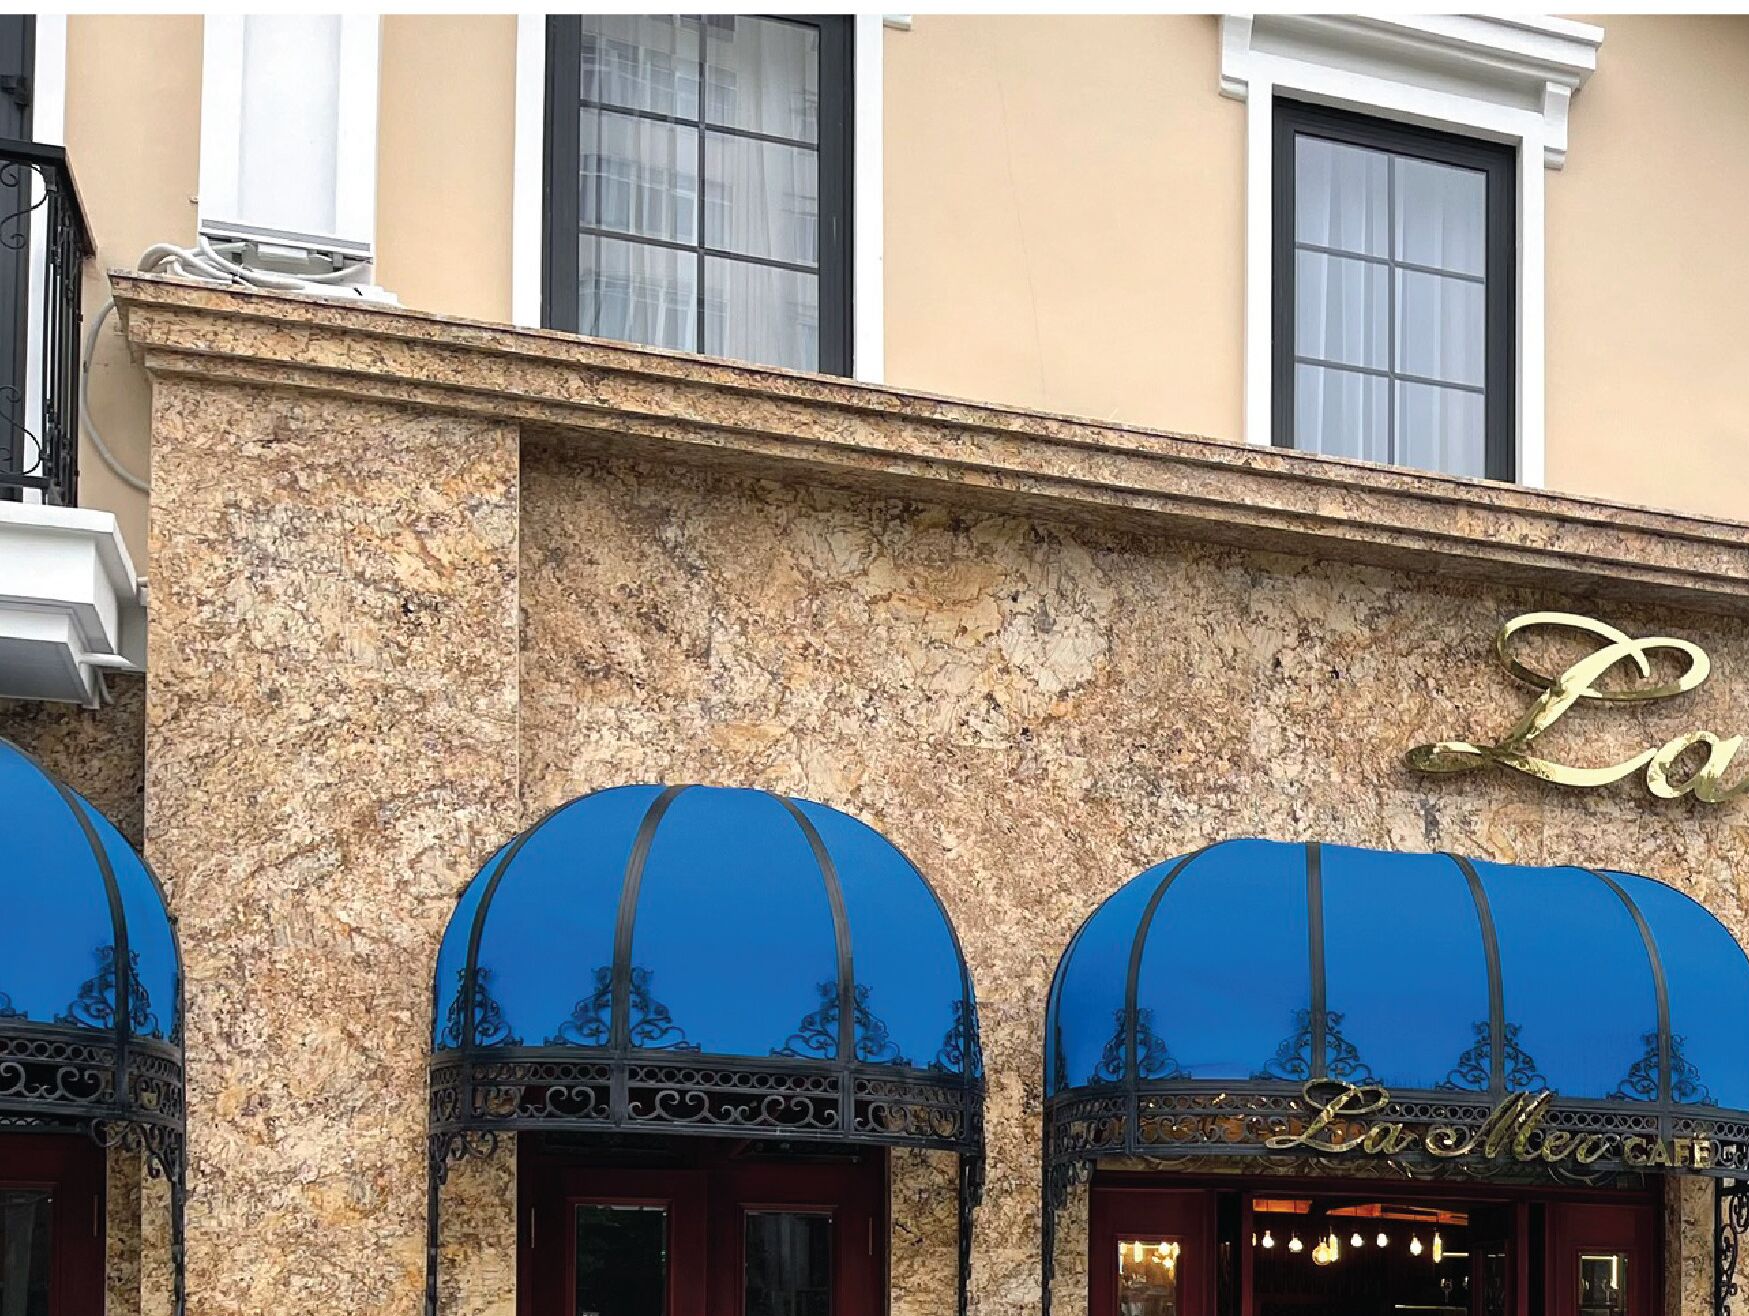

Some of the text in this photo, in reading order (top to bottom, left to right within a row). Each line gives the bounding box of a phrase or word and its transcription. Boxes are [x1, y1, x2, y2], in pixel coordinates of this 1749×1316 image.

[1265, 1078, 1714, 1170] La Mer CAFÉ
